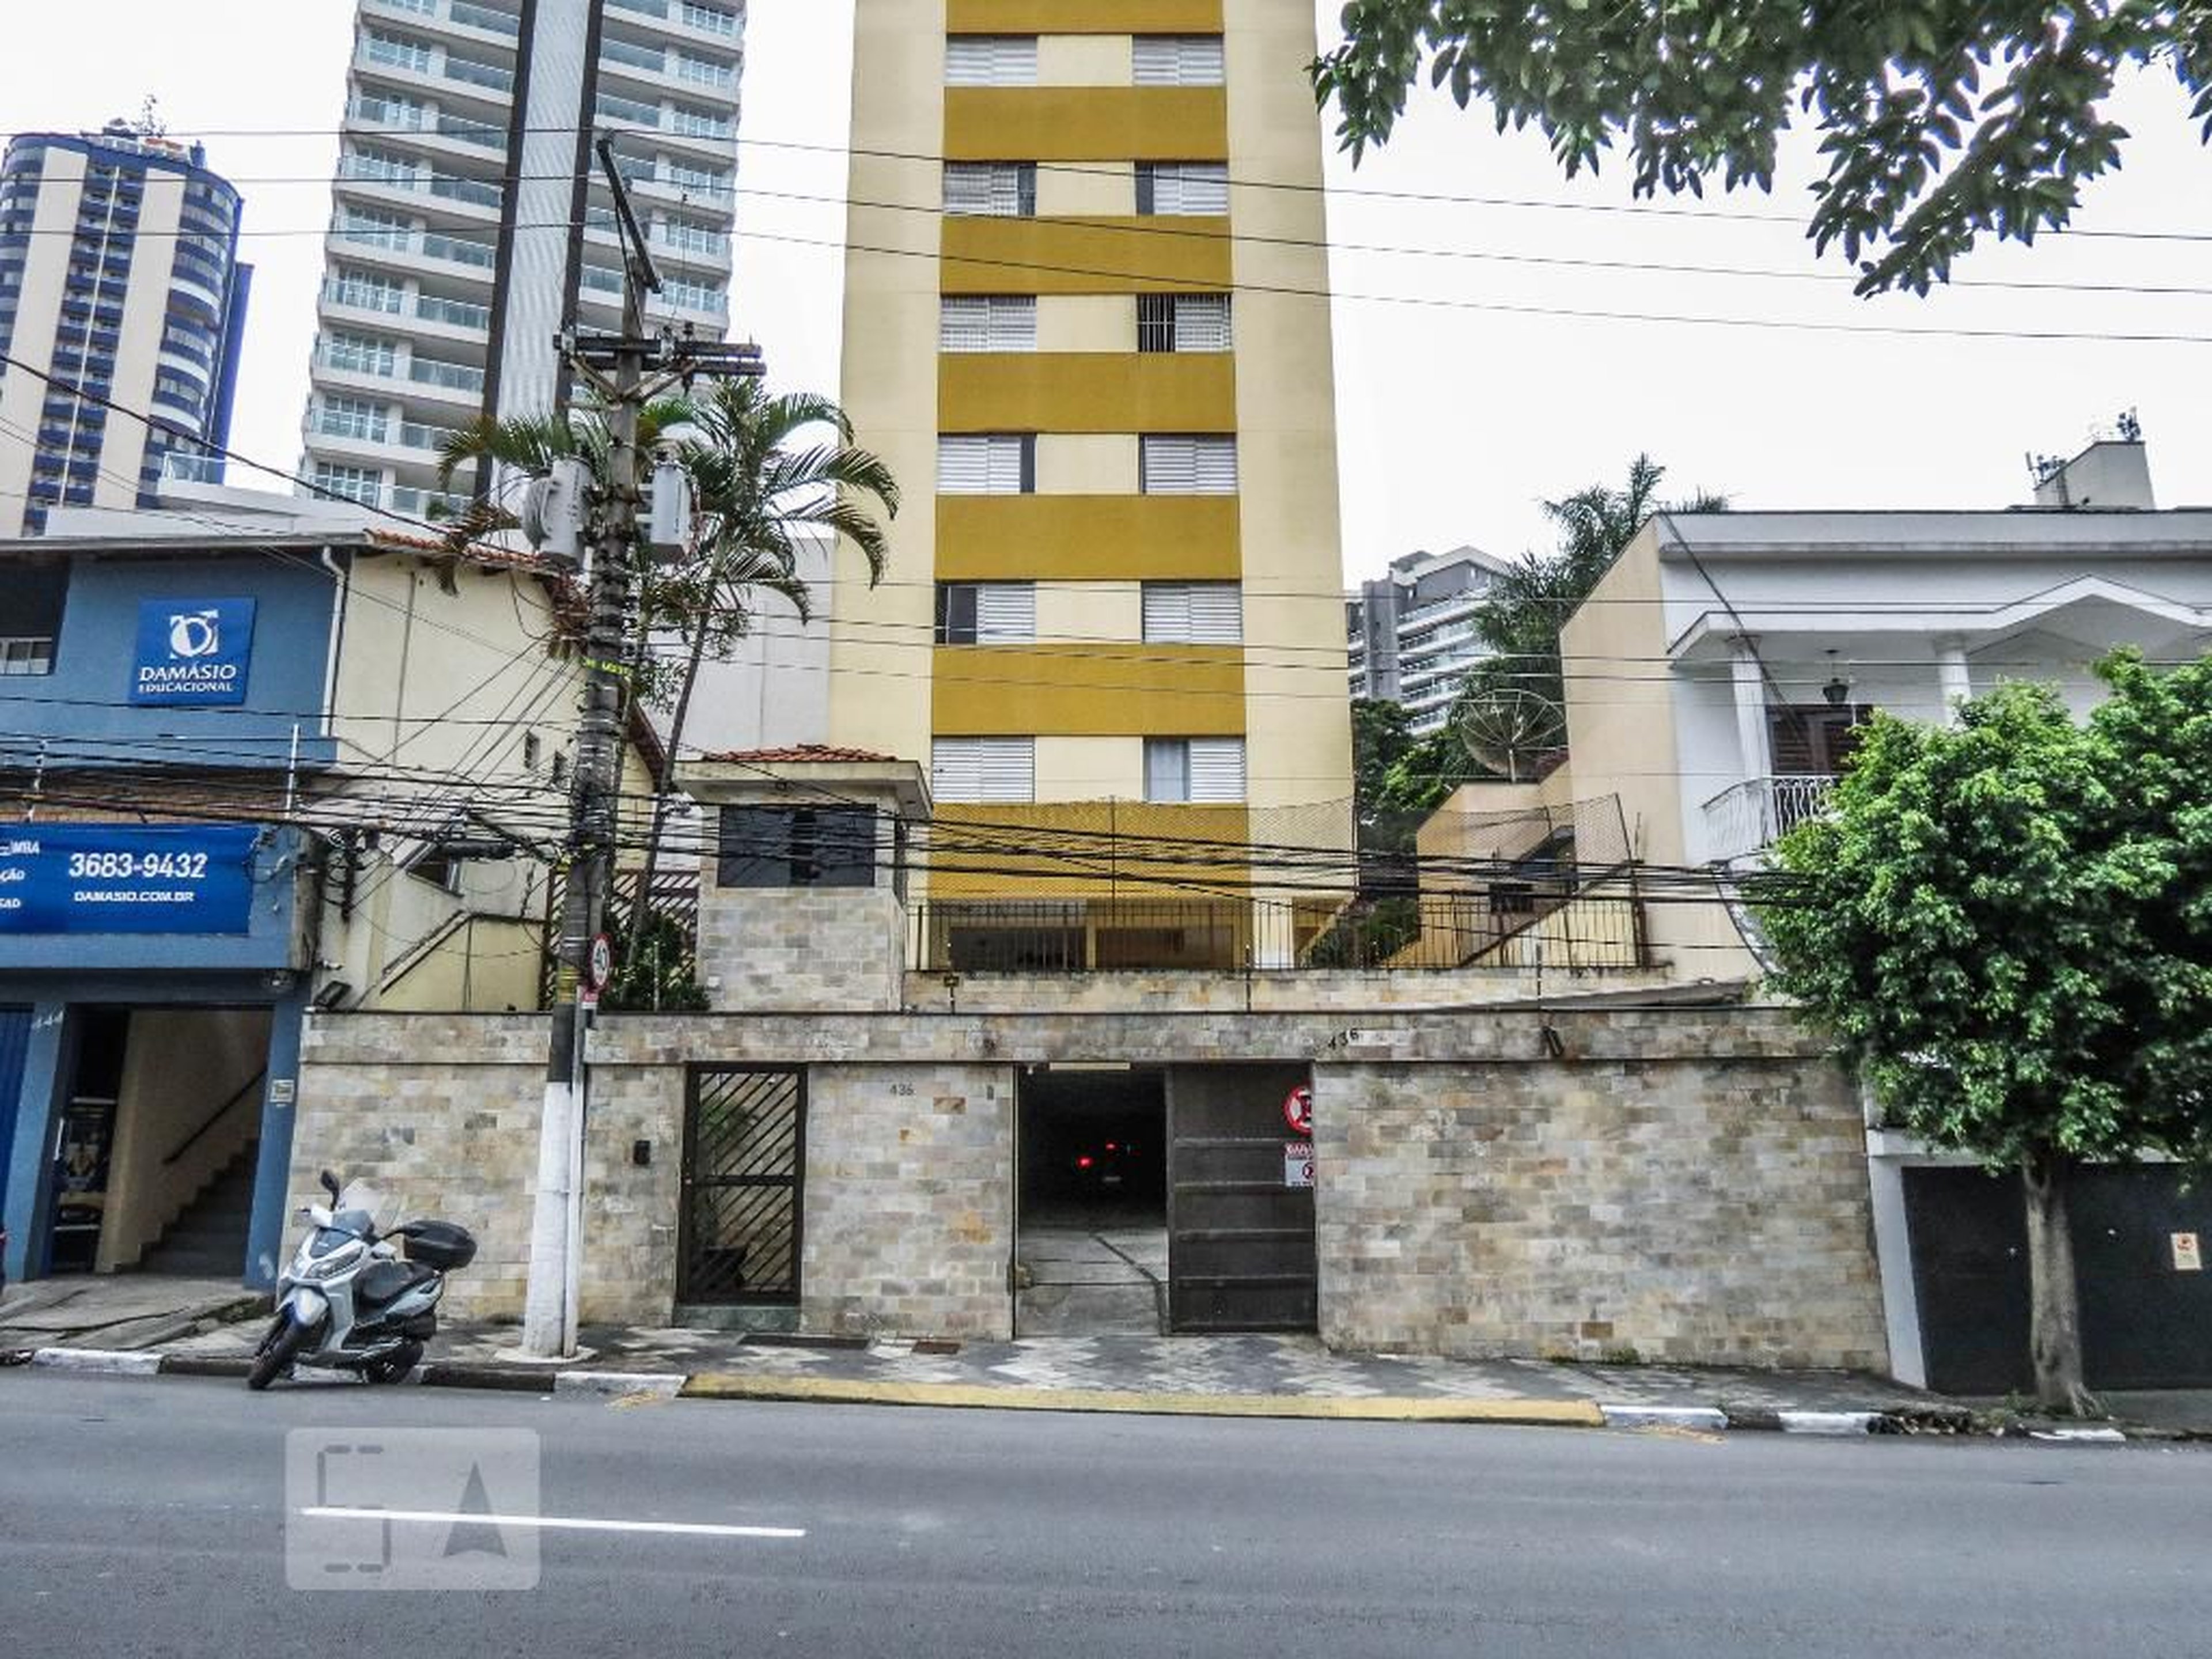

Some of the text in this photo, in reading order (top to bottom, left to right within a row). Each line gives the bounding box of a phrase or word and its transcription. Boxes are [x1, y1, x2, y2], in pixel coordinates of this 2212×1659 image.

[140, 661, 237, 681] DAMÁSIO
[138, 681, 233, 692] EDUCACIONAL
[69, 853, 208, 877] 3683-9432
[74, 891, 194, 902] DAMASIO.COM.BR
[1327, 1027, 1359, 1051] 436
[890, 1083, 915, 1096] 436
